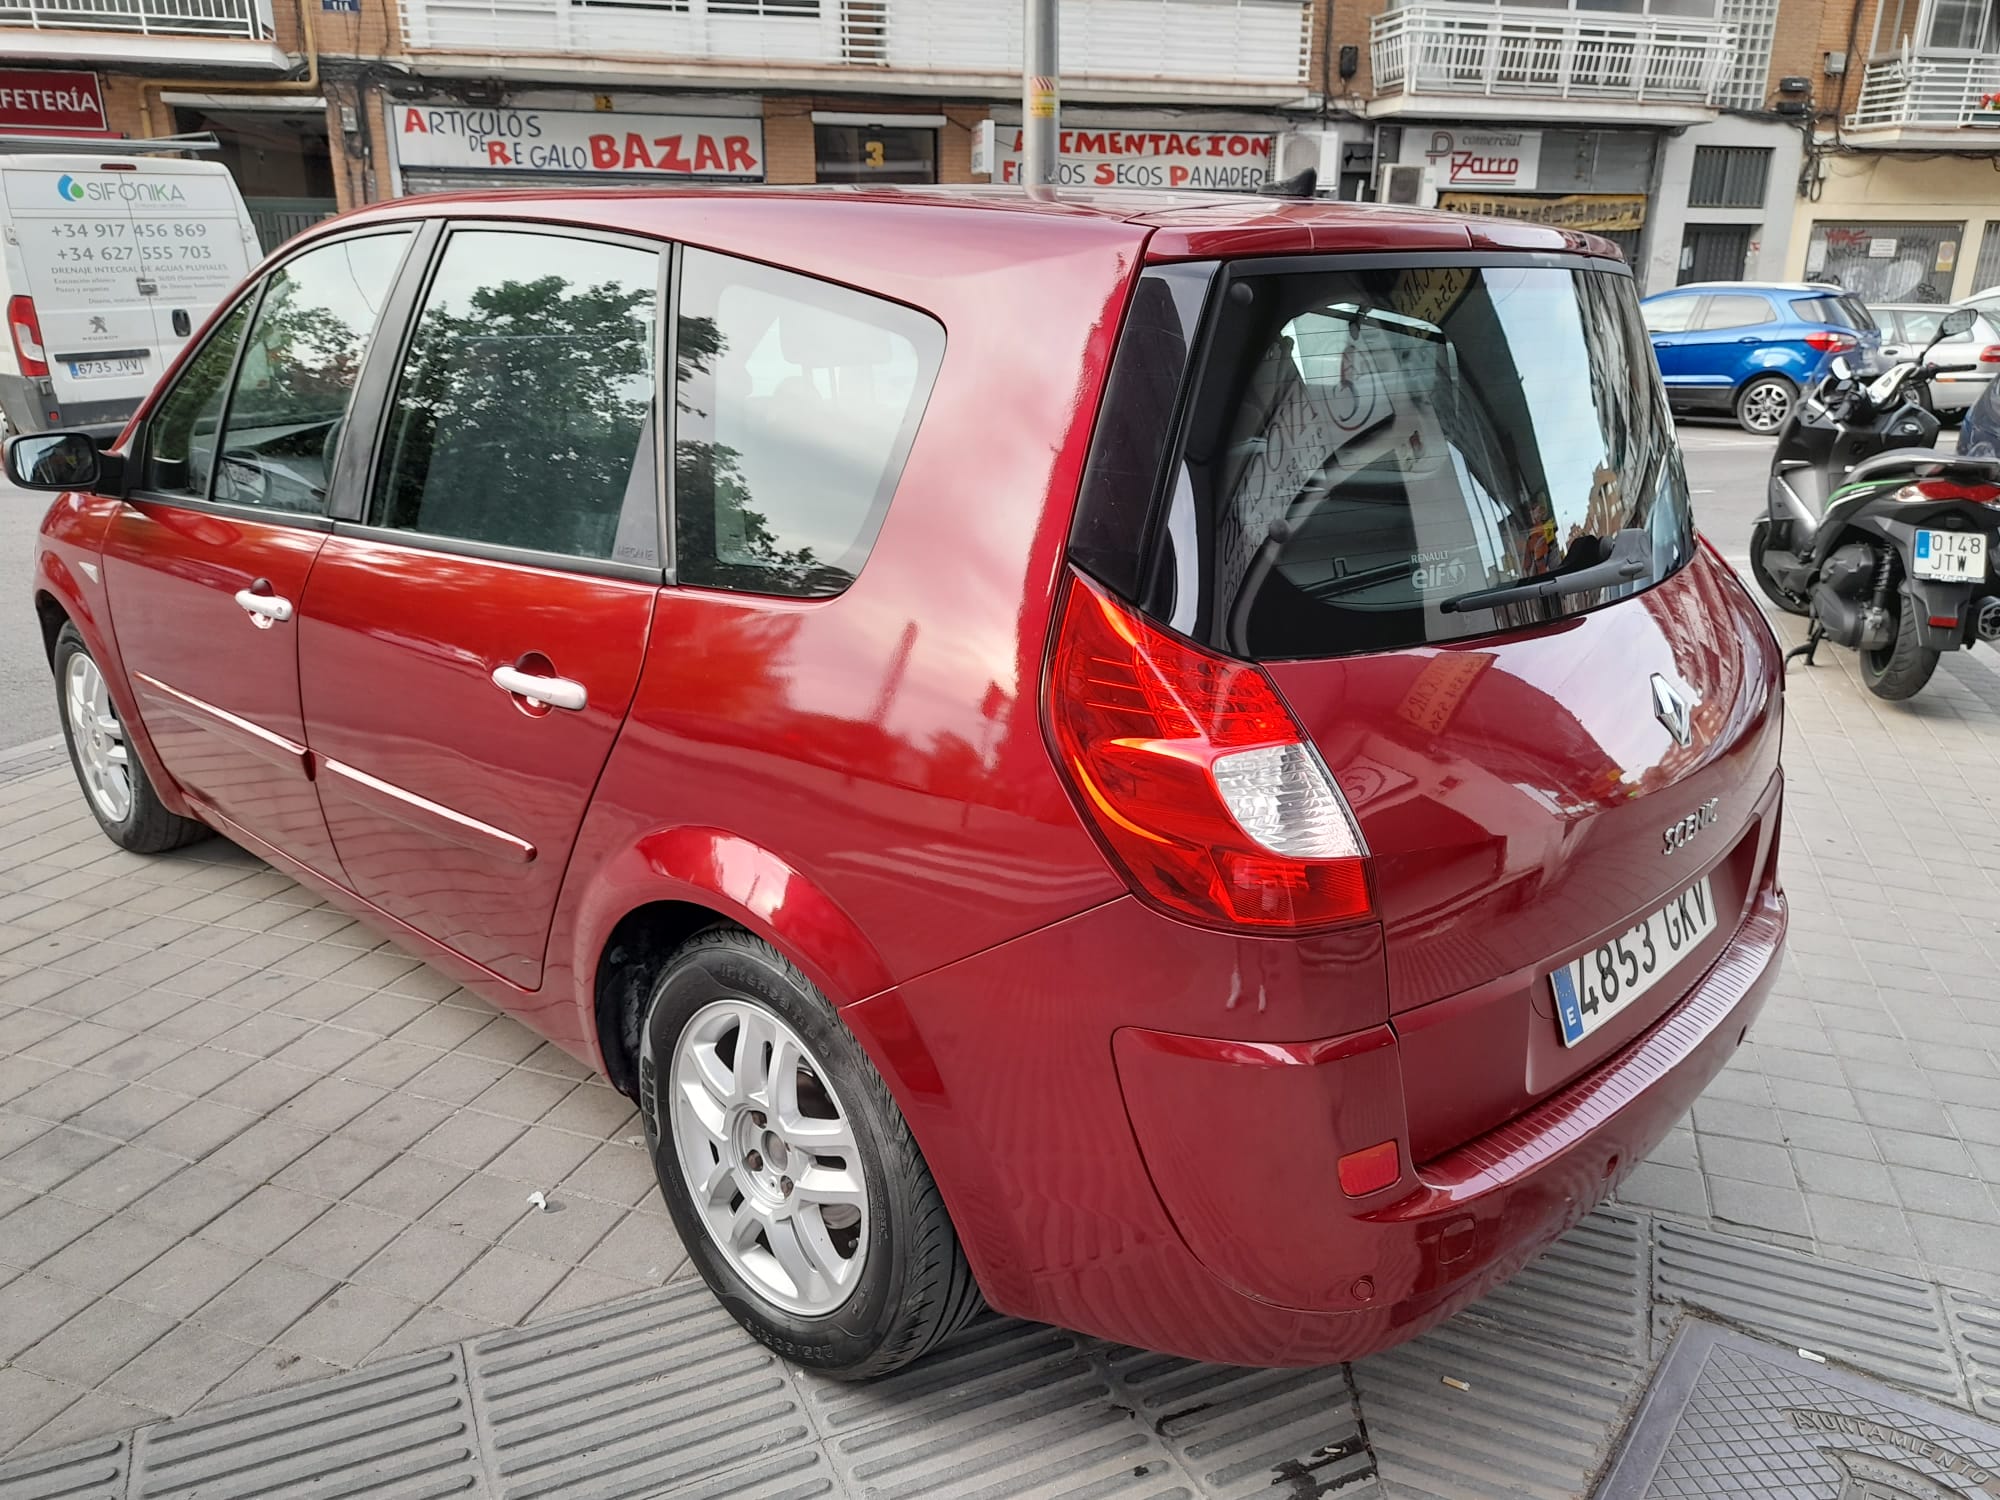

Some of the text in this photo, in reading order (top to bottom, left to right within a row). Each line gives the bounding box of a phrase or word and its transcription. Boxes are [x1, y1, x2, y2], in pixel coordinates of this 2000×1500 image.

[0, 86, 99, 112] FETERÍA
[469, 134, 487, 152] DE
[1013, 129, 1270, 157] IMENTACION
[1462, 133, 1523, 147] comercial
[589, 132, 757, 173] BAZAR
[866, 141, 883, 167] 3
[1094, 163, 1162, 186] SECOS
[52, 223, 206, 238] +34 917 456 869
[58, 246, 211, 261] +34 627 555 703
[52, 267, 92, 275] DRENAJE
[141, 265, 152, 273] DE
[78, 359, 138, 375] 6735 JVV
[1932, 534, 1981, 554] 0148
[1411, 550, 1449, 564] RENAULT
[1931, 553, 1967, 572] JTW
[1412, 563, 1446, 589] elf
[1662, 797, 1719, 856] SCENIC
[1579, 877, 1708, 1016] 4853 GKV
[1566, 1006, 1577, 1027] E
[1793, 1410, 1990, 1485] AYUNTAMIENTO
